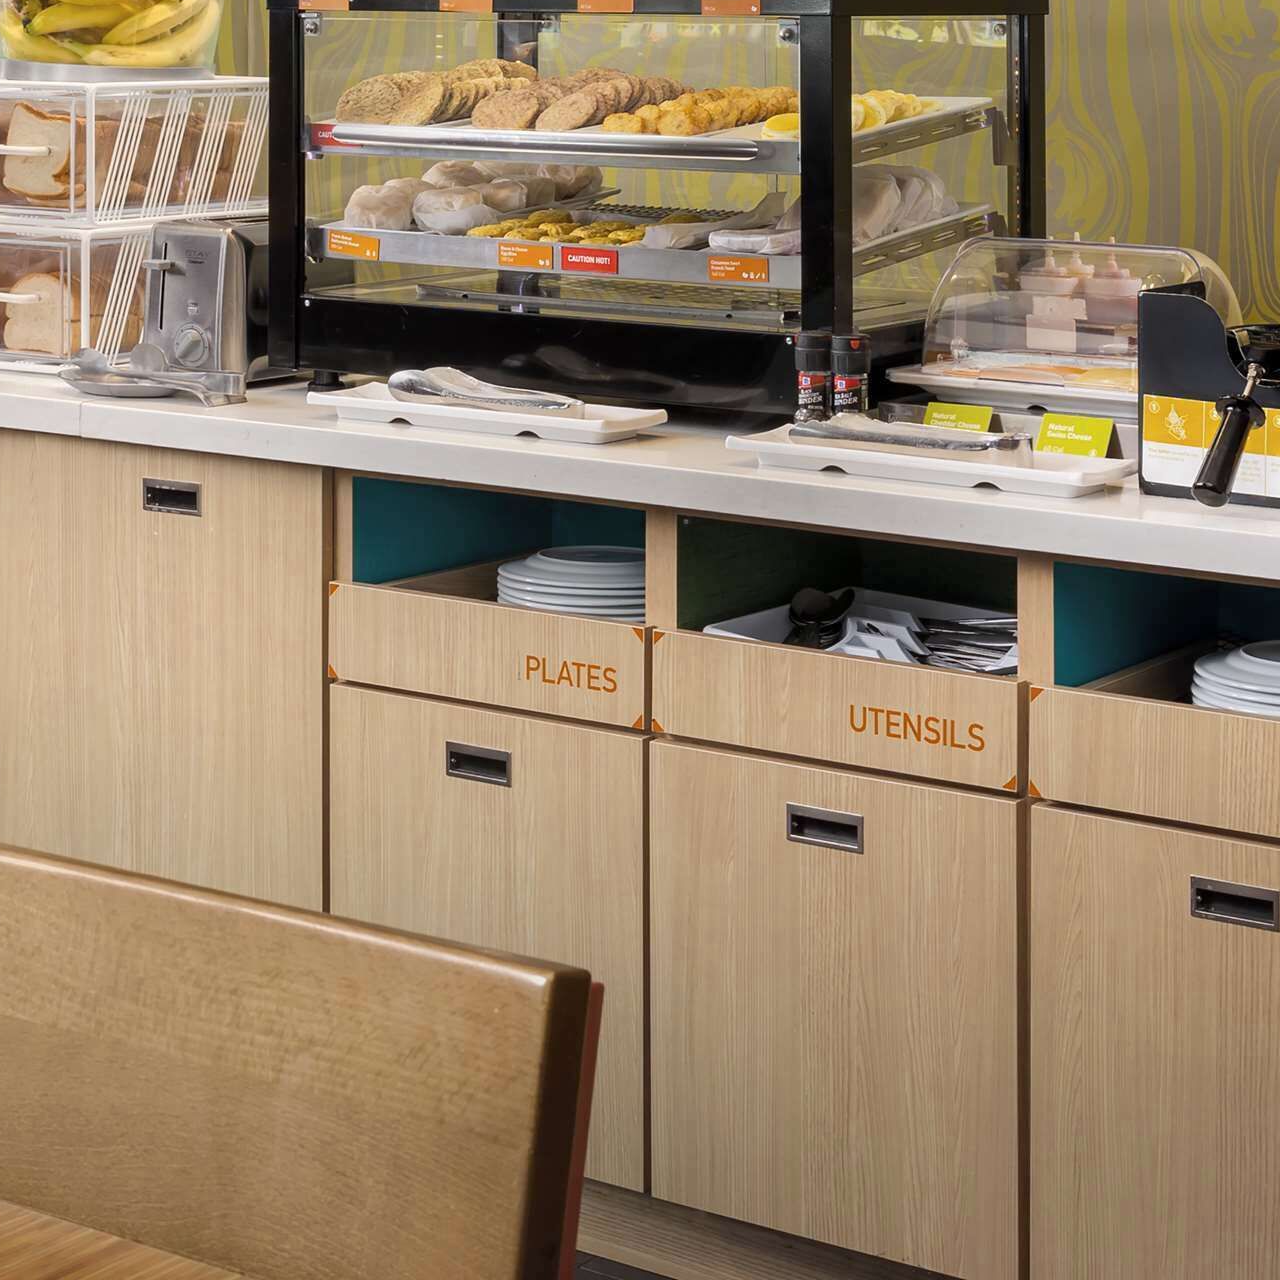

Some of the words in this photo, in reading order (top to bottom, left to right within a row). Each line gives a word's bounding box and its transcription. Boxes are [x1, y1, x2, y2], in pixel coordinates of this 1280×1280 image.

[567, 254, 595, 264] CAUTION
[595, 256, 611, 265] HOT!
[524, 654, 618, 694] PLATES
[849, 703, 986, 753] UTENSILS
